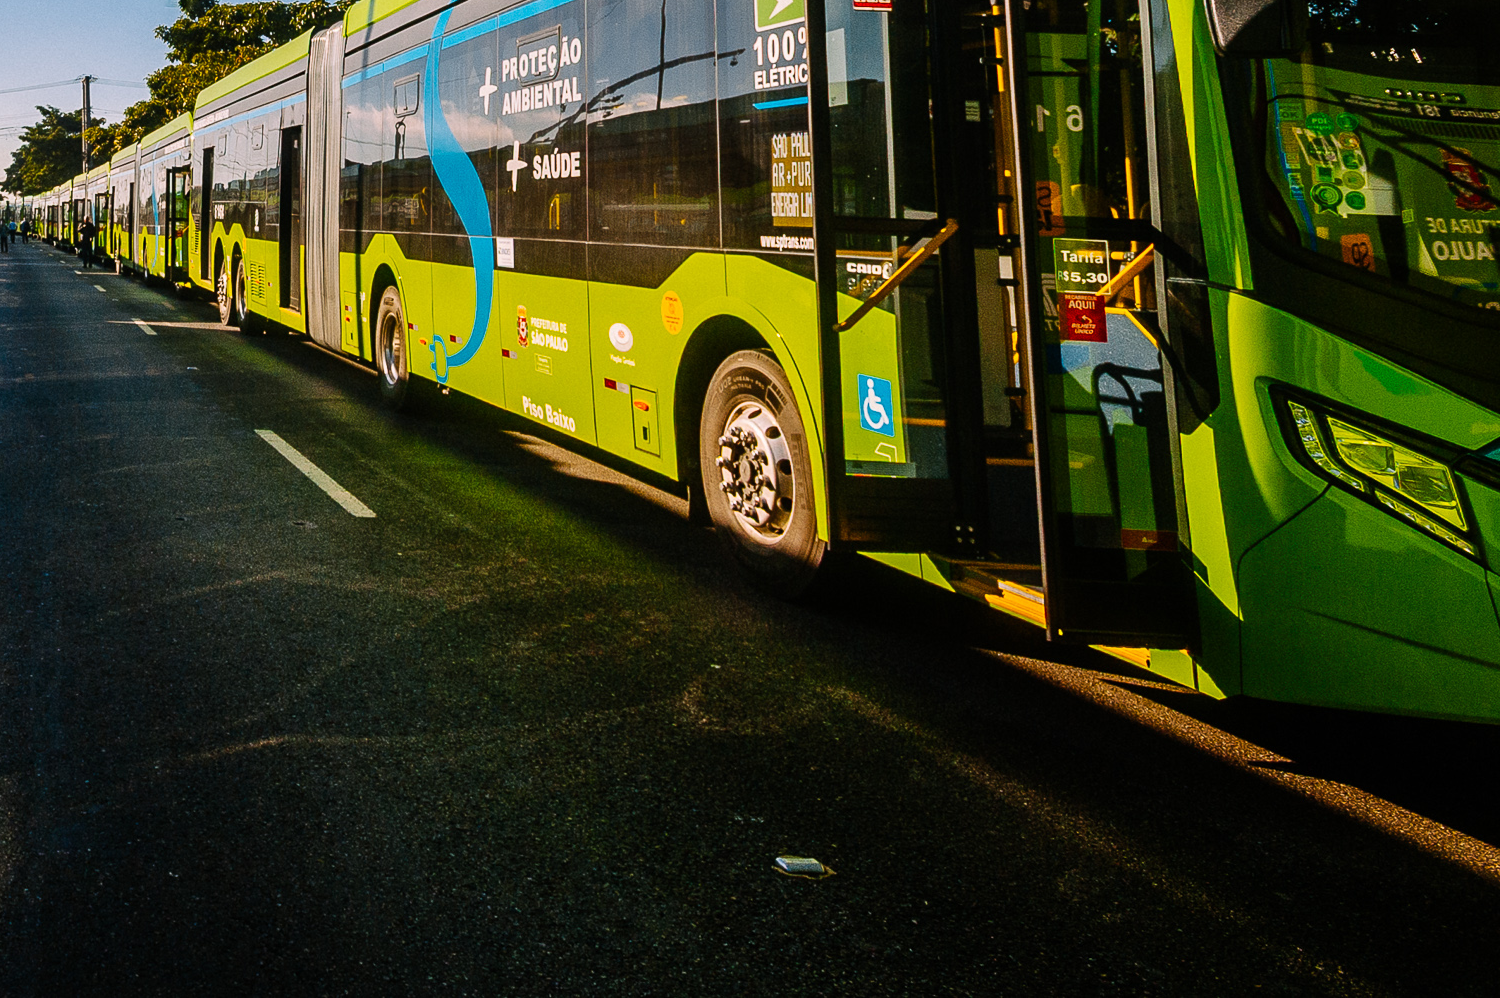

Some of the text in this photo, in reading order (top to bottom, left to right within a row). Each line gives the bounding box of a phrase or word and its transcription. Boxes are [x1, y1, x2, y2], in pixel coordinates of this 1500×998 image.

[502, 35, 582, 83] PROTEÇÃO
[502, 76, 582, 115] AMBIENTAL
[533, 147, 581, 180] SAÚDE
[1060, 250, 1104, 265] Tarifa
[530, 317, 567, 334] PREFEITURA DE
[531, 330, 568, 352] SÃO PAULO
[522, 395, 576, 433] Piso Baixo
